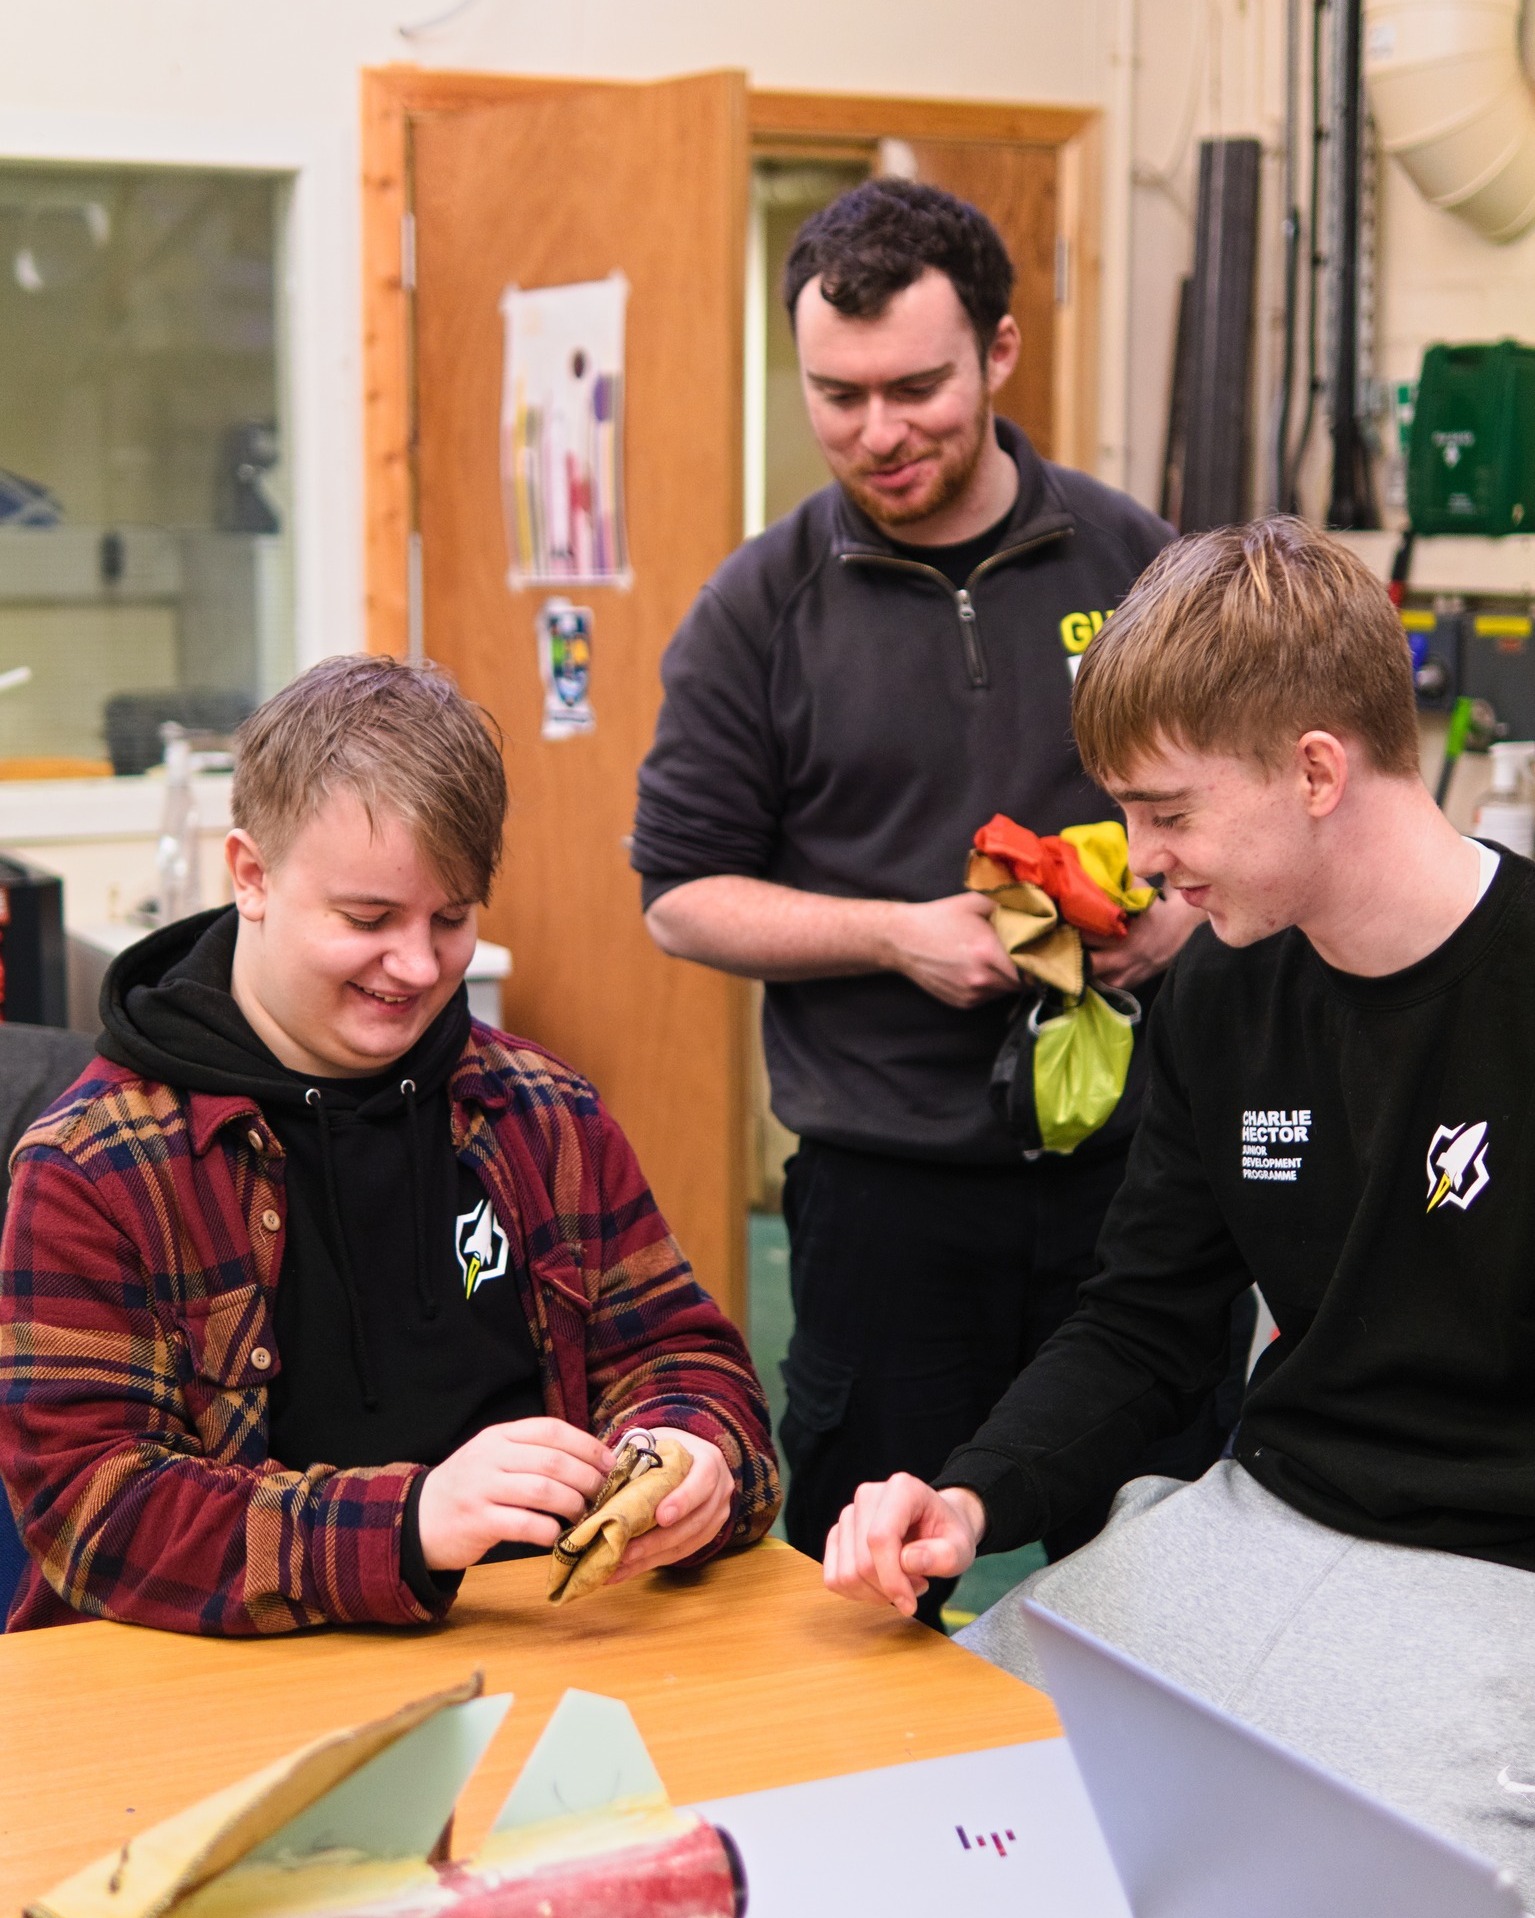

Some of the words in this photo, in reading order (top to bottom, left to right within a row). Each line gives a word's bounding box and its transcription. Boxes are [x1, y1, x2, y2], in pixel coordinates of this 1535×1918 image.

[1241, 1109, 1312, 1126] CHARLIE
[1241, 1126, 1309, 1143] HECTOR
[1242, 1144, 1267, 1156] JUNIOR
[1241, 1156, 1302, 1168] DEVELOPMENT
[1242, 1168, 1297, 1181] PROGRAMME
